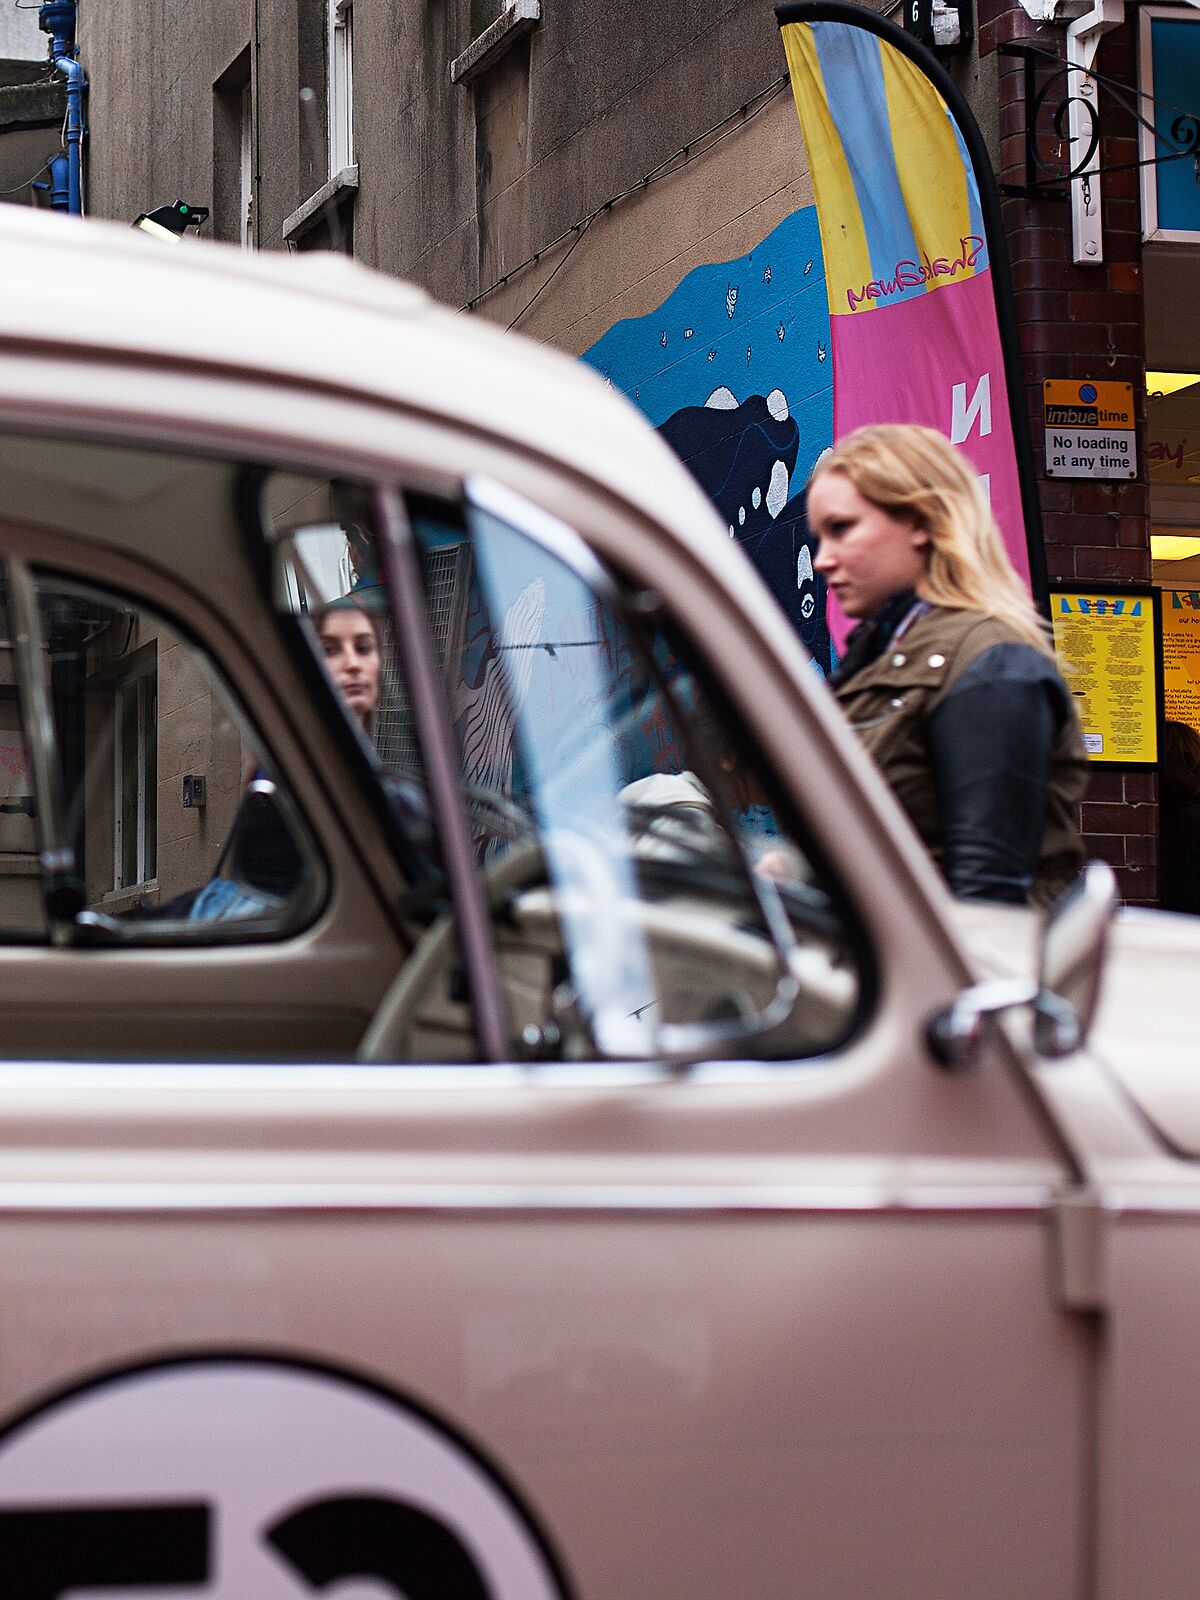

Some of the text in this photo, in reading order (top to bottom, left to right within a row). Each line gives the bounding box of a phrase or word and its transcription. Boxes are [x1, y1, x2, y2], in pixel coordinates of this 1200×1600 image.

[1053, 436, 1128, 453] No loading
[1053, 455, 1130, 469] at any time
